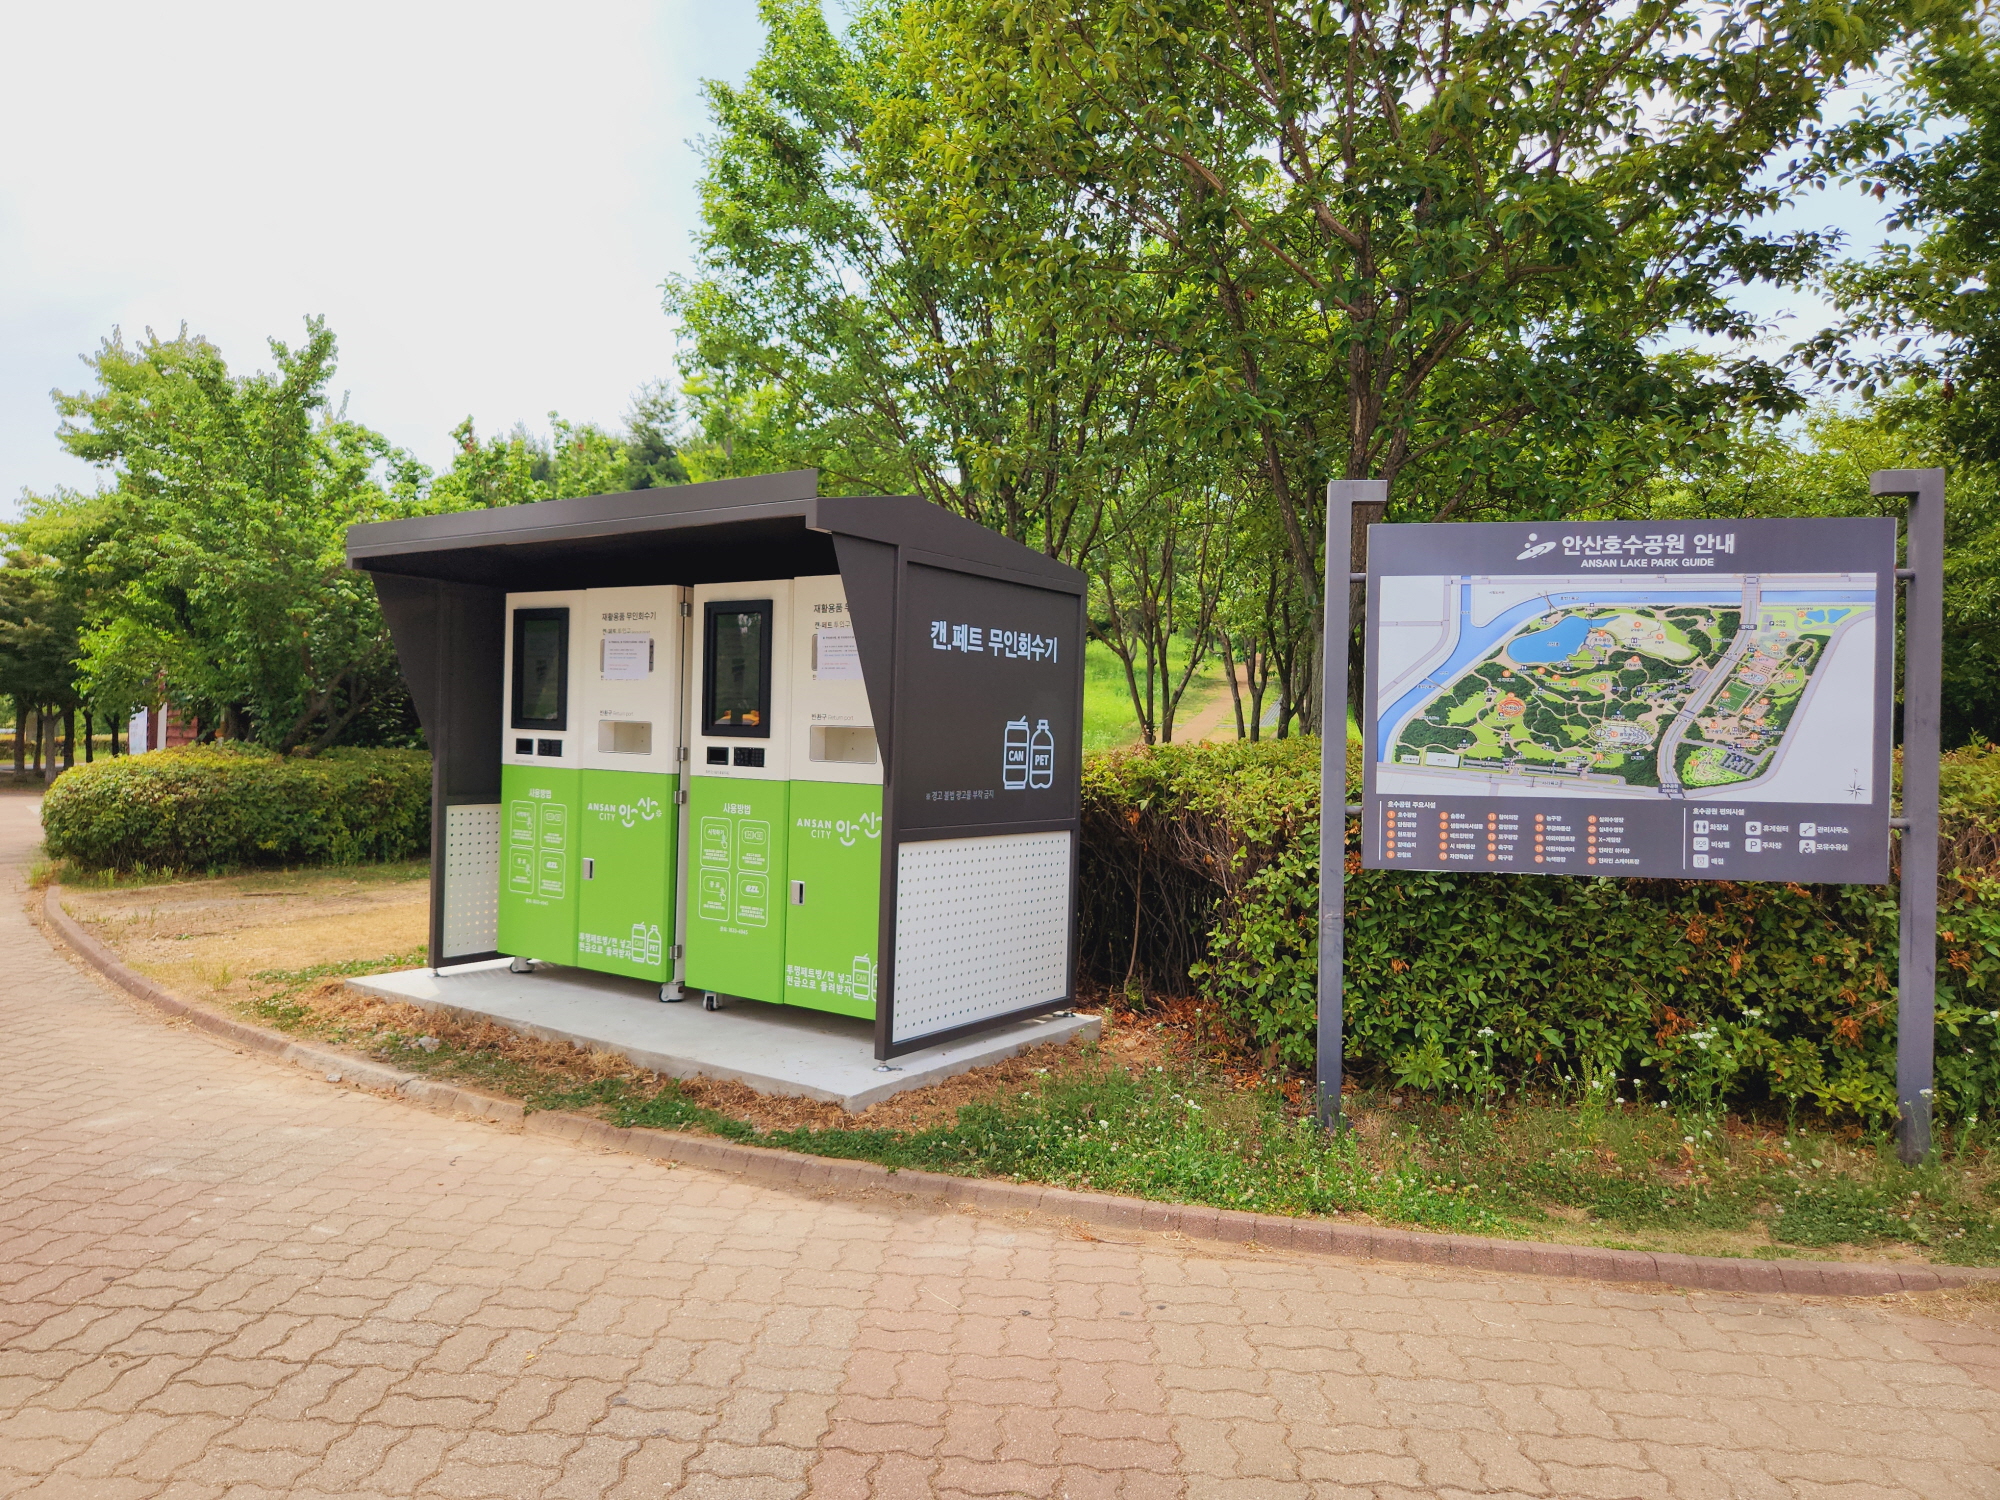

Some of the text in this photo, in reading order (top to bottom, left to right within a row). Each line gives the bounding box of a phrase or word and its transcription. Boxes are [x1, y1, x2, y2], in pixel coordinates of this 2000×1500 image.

[1561, 533, 1735, 556] 안산호수공원 안내
[1580, 557, 1715, 568] ANSAN LAKE PARK GUIDE
[813, 603, 843, 614] 재활용품
[601, 611, 657, 622] 재활용품 무인회수기
[988, 628, 1058, 664] 무인회수기
[1008, 750, 1024, 762] CAN
[1034, 754, 1050, 766] PET
[587, 803, 616, 813] ANSAN
[722, 802, 751, 815] 사용방법
[599, 812, 616, 822] CITY
[796, 818, 832, 829] ANSAN
[810, 829, 832, 839] CITY
[1816, 826, 1849, 834] 관리사무소
[649, 944, 658, 952] PET
[786, 964, 852, 984] 투명페트병/캔 넣고
[856, 974, 867, 982] CAN
[786, 975, 852, 996] 현금으로 돌려받자
